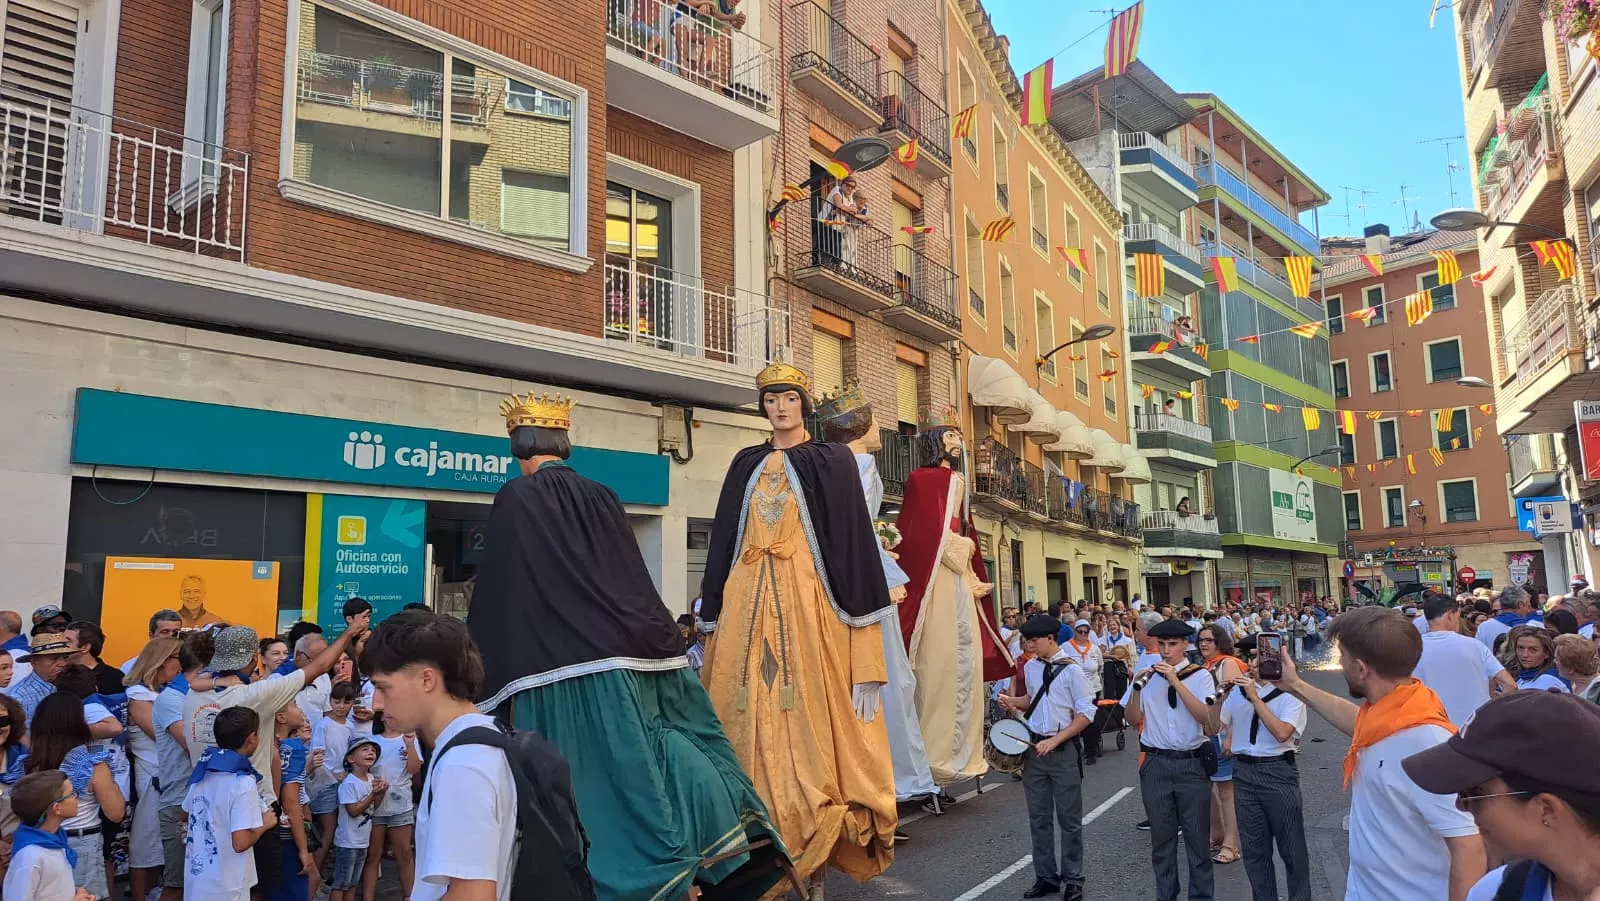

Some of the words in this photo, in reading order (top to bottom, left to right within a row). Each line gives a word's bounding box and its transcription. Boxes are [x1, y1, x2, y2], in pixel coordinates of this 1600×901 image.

[394, 441, 512, 477] cajamar
[454, 472, 478, 482] CAJA
[336, 549, 377, 562] Oficina
[380, 552, 402, 562] con
[335, 562, 409, 574] Autoservicio
